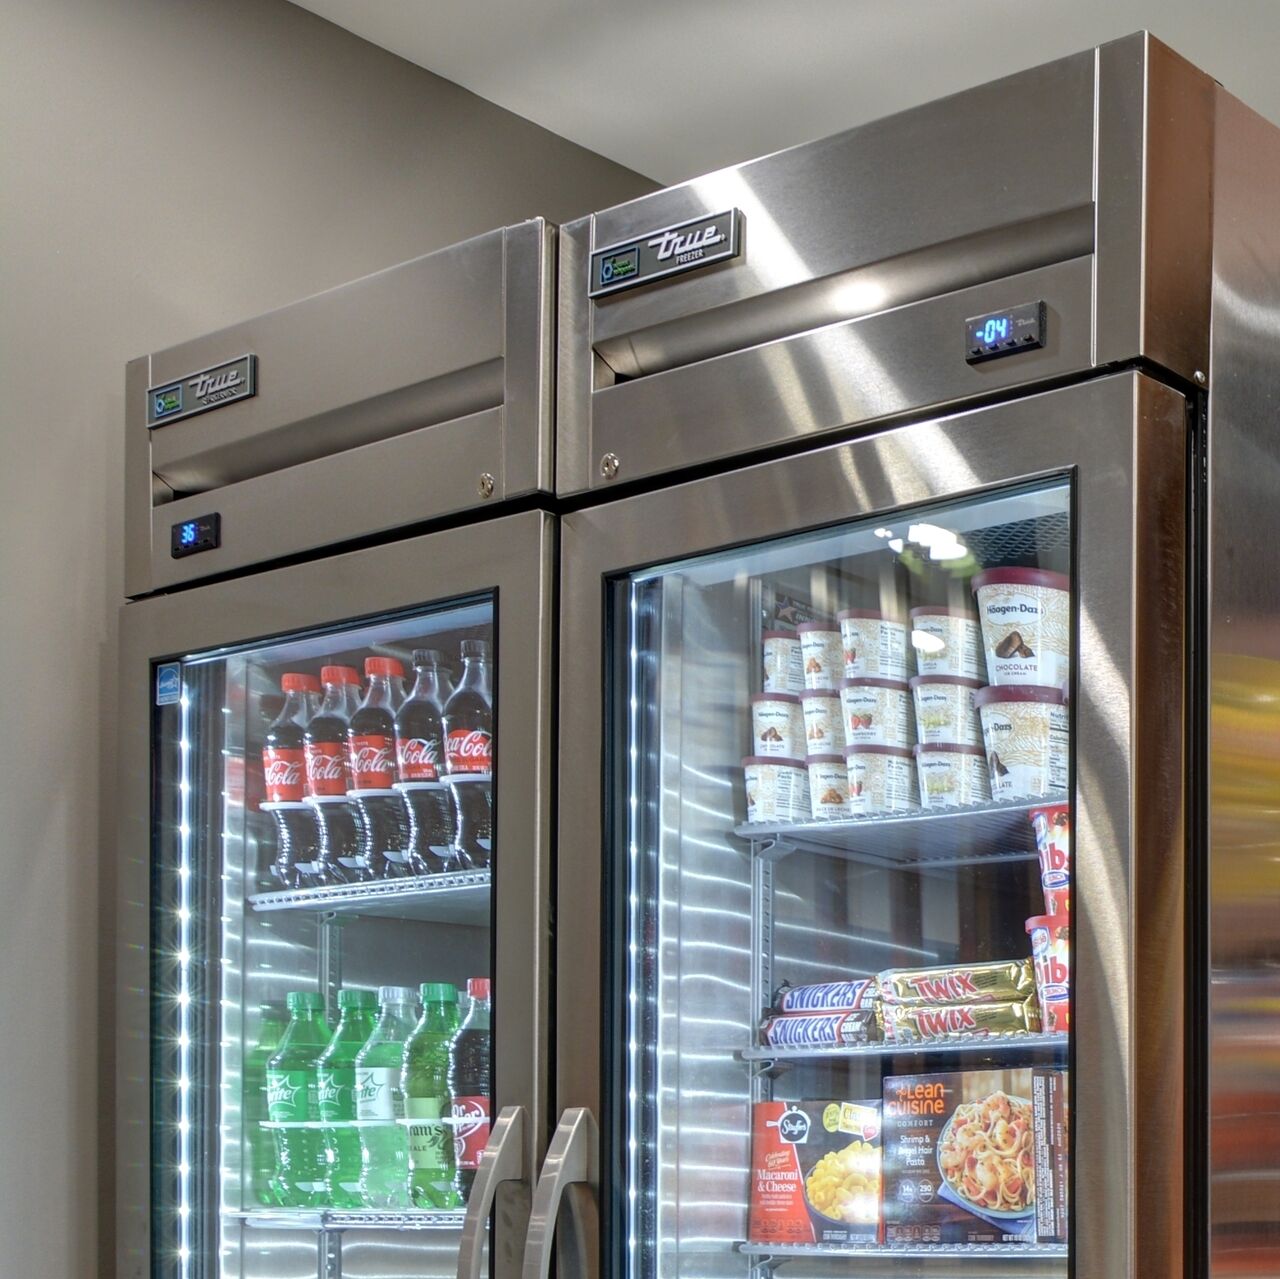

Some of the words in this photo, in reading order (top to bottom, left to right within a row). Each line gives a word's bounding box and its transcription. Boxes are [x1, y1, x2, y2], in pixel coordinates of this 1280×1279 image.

[675, 249, 704, 264] FREEZER
[181, 523, 195, 543] 36
[996, 664, 1038, 672] CHOCOLATE
[786, 981, 862, 1011] SNICKERS
[910, 973, 977, 1004] TWIX
[770, 1015, 837, 1045] SNICKERS
[908, 1008, 974, 1038] TWIX
[757, 1169, 798, 1180] Macaroni
